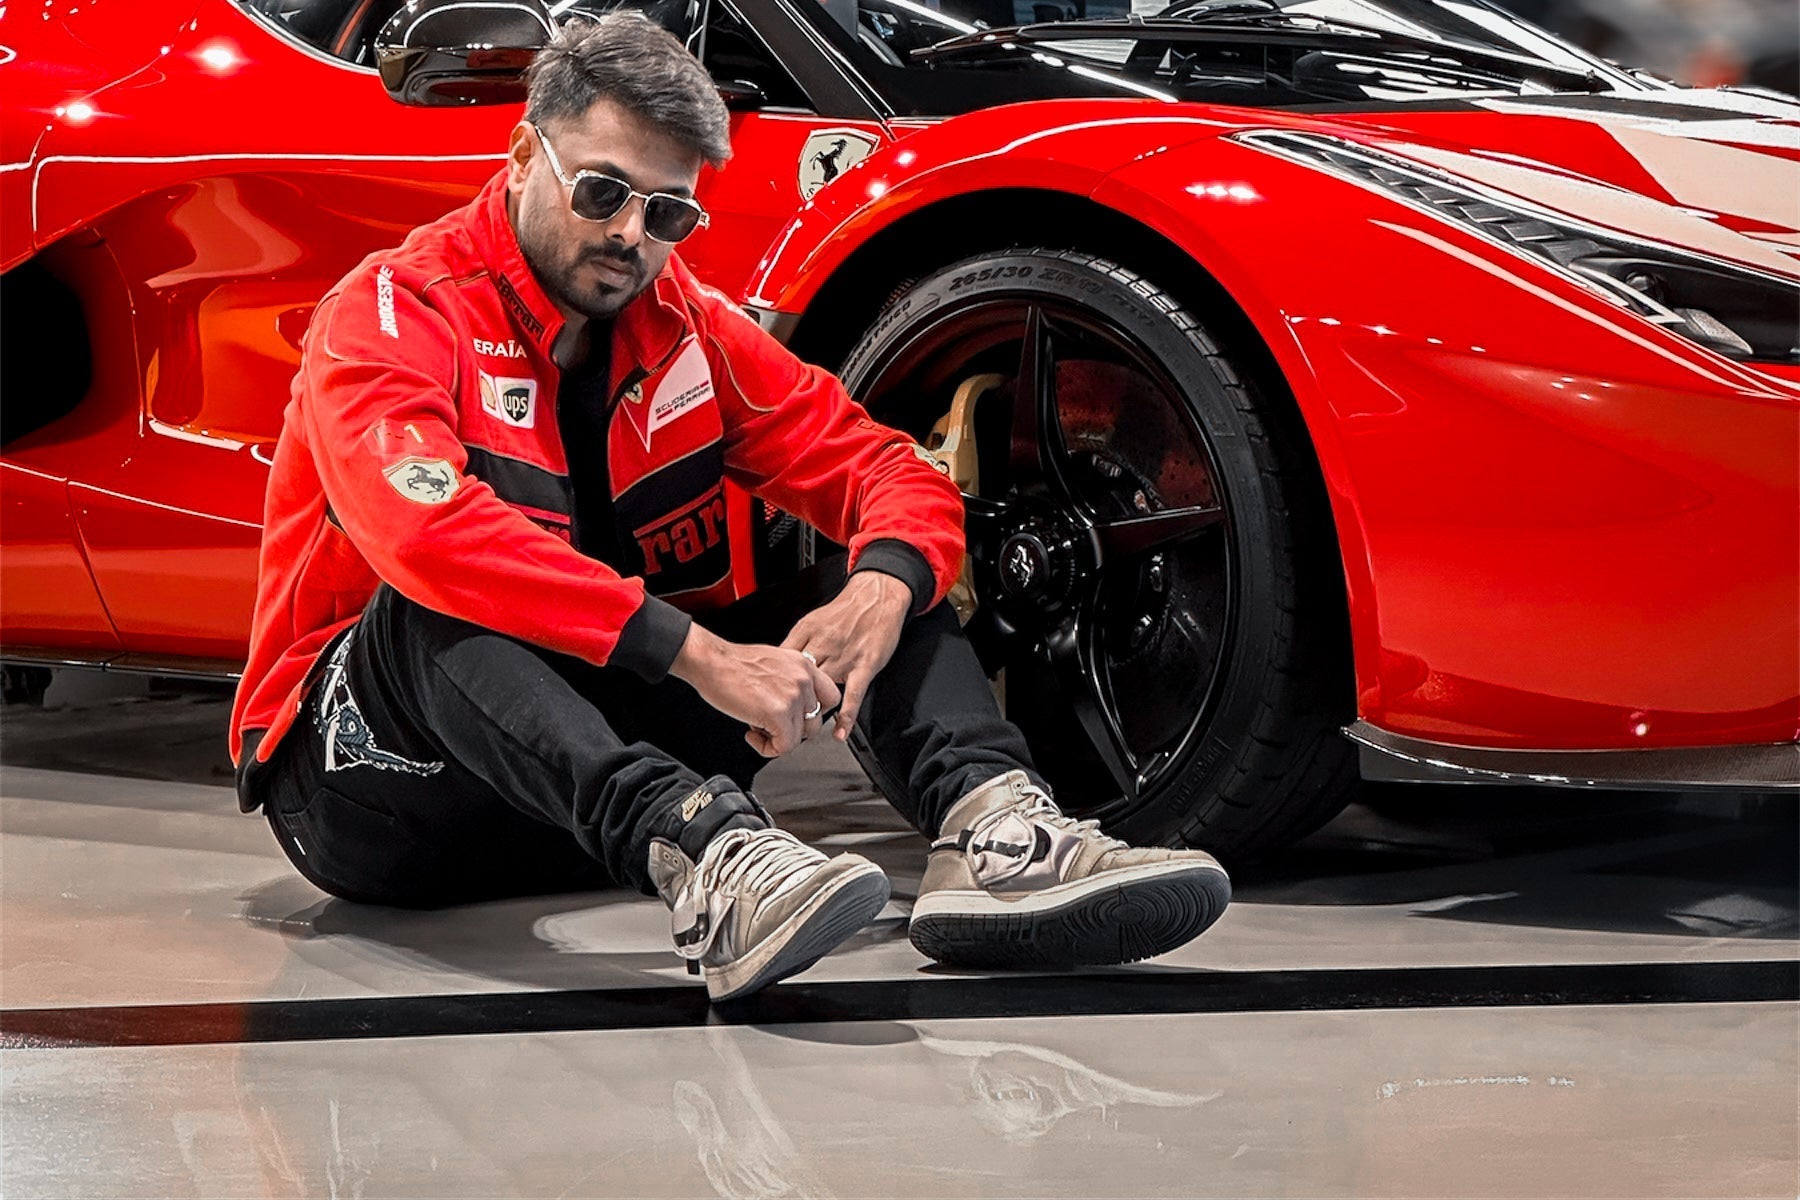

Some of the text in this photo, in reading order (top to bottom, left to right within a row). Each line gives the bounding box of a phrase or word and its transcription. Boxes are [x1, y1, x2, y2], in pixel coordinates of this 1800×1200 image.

[949, 265, 1033, 291] 265/30
[1037, 267, 1074, 286] ZR
[503, 395, 529, 417] ups
[656, 385, 700, 414] SCUDERIA
